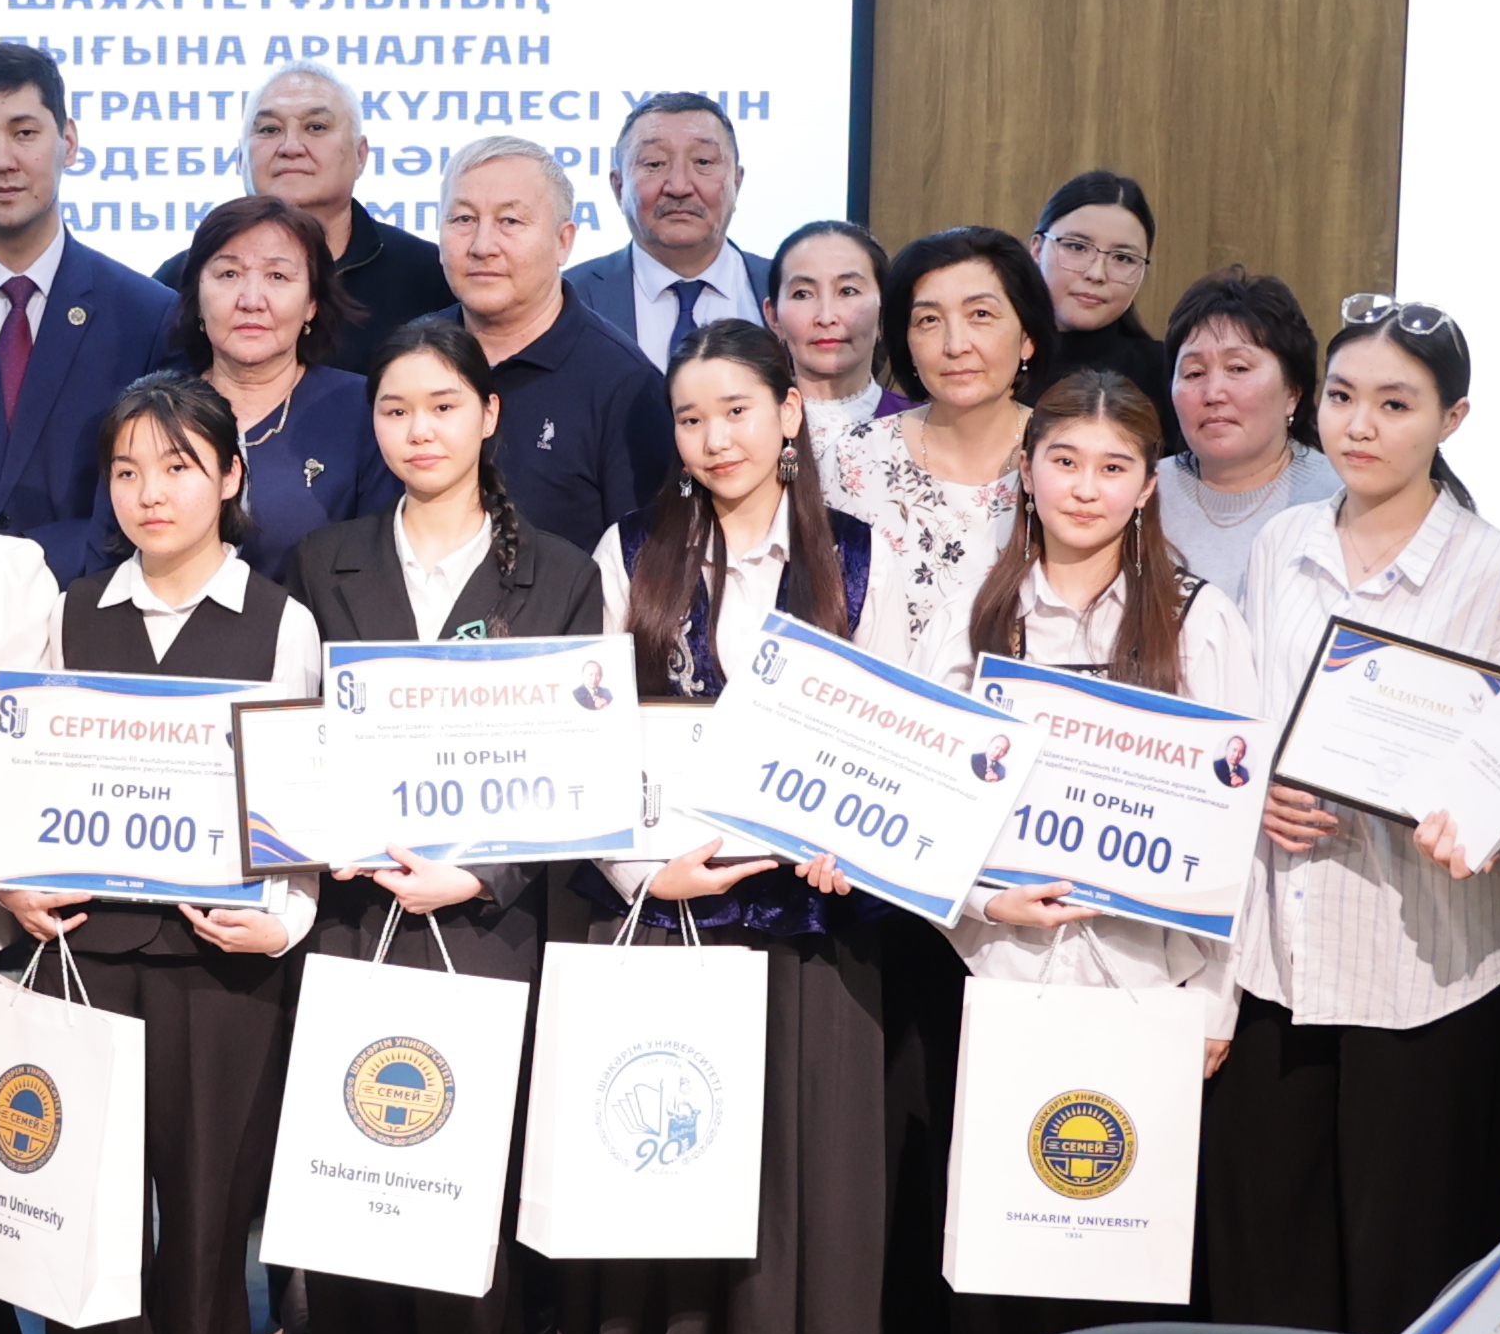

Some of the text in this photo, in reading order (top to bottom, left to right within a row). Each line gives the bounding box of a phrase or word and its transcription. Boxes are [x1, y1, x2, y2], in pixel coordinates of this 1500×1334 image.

[263, 34, 550, 66] АРНАЛҒАН
[388, 683, 560, 709] СЕРТИФИКАТ
[1375, 684, 1455, 717] МАДАҚТАМА
[49, 715, 216, 745] СЕРТИФИКАТ
[800, 675, 964, 758] СЕРТИФИКАТ
[463, 749, 527, 765] ОРЫН
[1034, 711, 1204, 770] СЕРТИФИКАТ
[111, 784, 171, 801] ОРЫН
[842, 761, 902, 795] ОРЫН
[392, 779, 464, 818] 100
[480, 776, 556, 815] 000
[759, 760, 826, 812] 100
[834, 793, 909, 848] 000
[1092, 793, 1155, 819] ОРЫН
[37, 807, 110, 847] 200
[125, 813, 196, 853] 000
[1014, 804, 1084, 853] 100
[1098, 824, 1172, 874] 000
[350, 1038, 393, 1075] ШӘКӘРІМ
[596, 1039, 723, 1093] ШӘКӘРІМ УНИВЕРСИТЕТІ
[377, 1087, 421, 1102] СЕМЕЙ
[10, 1111, 40, 1131] СЕМЕЙ
[1034, 1093, 1134, 1136] ШӘКӘРІМ УНИВЕРСИТЕТІ
[634, 1138, 682, 1173] 90
[1061, 1141, 1105, 1154] СЕМЕЙ
[310, 1160, 463, 1200] Shakarim University
[9, 1195, 64, 1231] University
[367, 1200, 401, 1216] 1934
[1006, 1211, 1150, 1229] SHAKARIM UNIVERSITY
[1064, 1231, 1083, 1239] 1934
